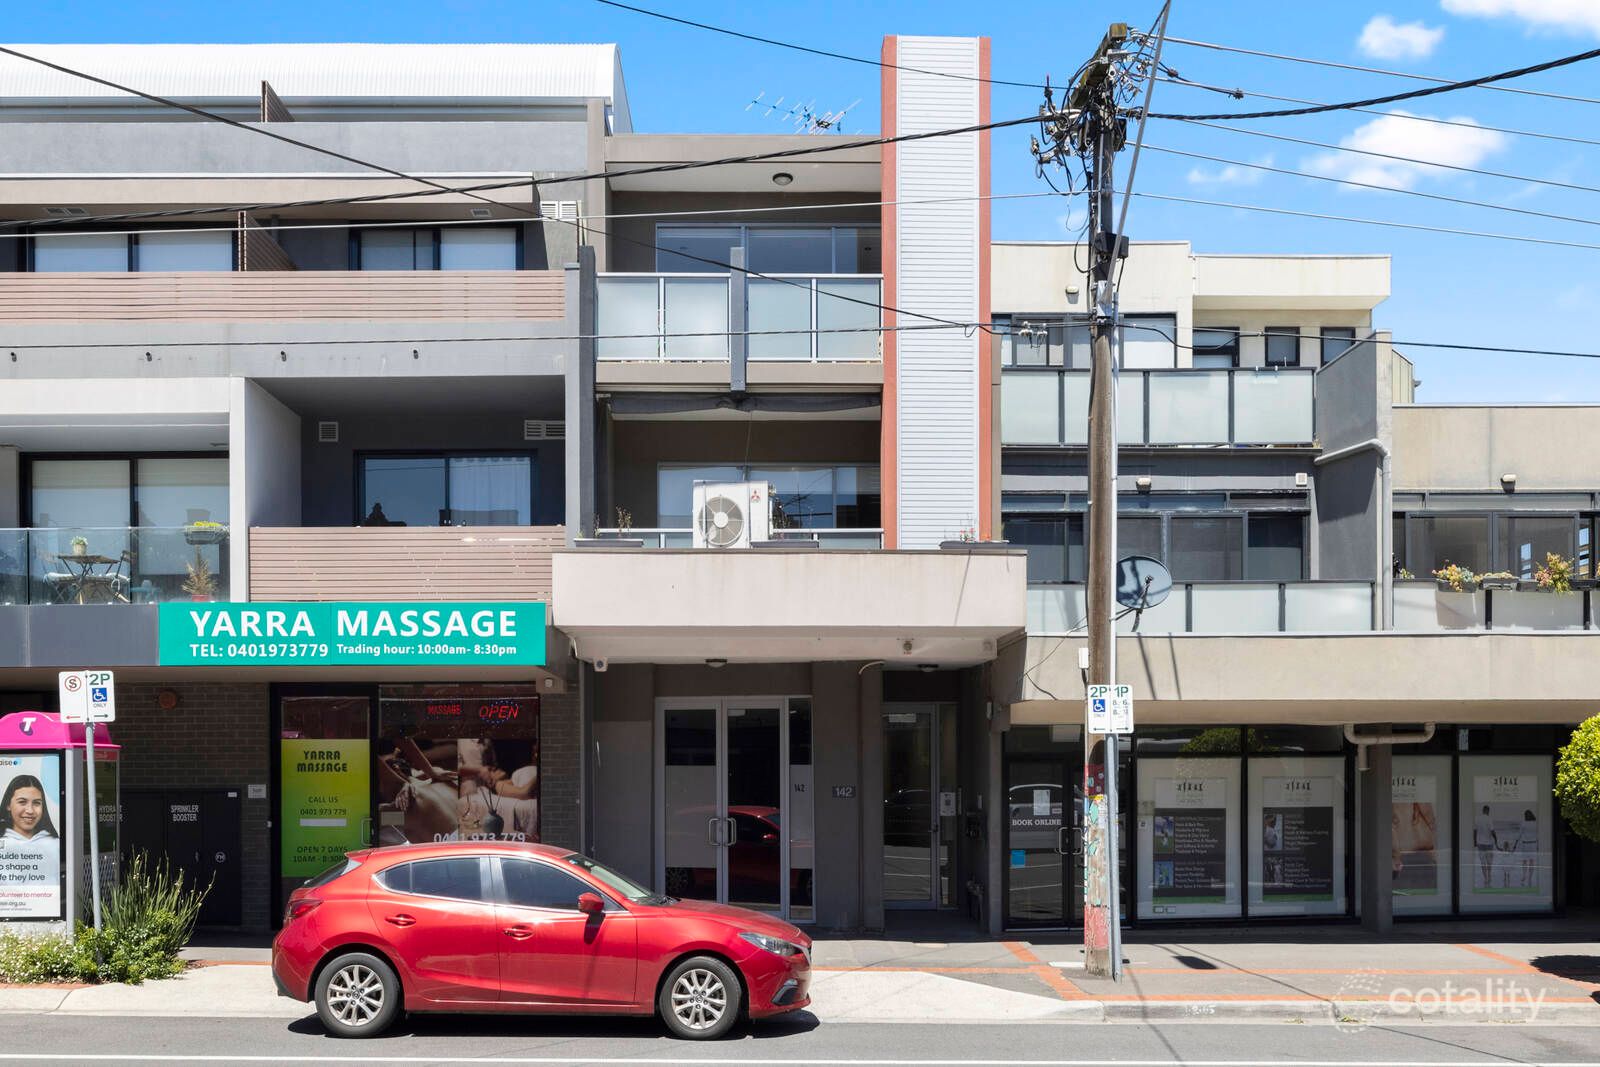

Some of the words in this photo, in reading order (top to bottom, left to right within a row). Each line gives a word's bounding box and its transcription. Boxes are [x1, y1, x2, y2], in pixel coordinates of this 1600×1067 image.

[190, 610, 316, 637] YARRA
[337, 609, 517, 637] MASSAGE
[190, 644, 224, 657] TEL:
[227, 644, 329, 657] 0401973779
[337, 643, 381, 657] Trading
[384, 643, 415, 655] hour:
[474, 643, 517, 657] 8:30pm
[89, 673, 111, 686] 2P
[1090, 686, 1108, 698] 2P
[1114, 686, 1129, 698] 1P
[479, 705, 519, 719] OPEN
[303, 750, 341, 761] YARRA
[297, 763, 348, 773] MASSAGE
[835, 786, 853, 797] 142
[308, 796, 326, 804] CALL
[328, 796, 339, 804] US
[98, 805, 123, 813] HYDRAT
[170, 805, 199, 813] SPRINKLER
[300, 808, 317, 816] 0401
[99, 813, 123, 822] BOOSTR
[172, 813, 198, 822] BOOSTER
[5, 863, 31, 873] shape
[9, 873, 28, 884] they
[28, 873, 46, 881] love
